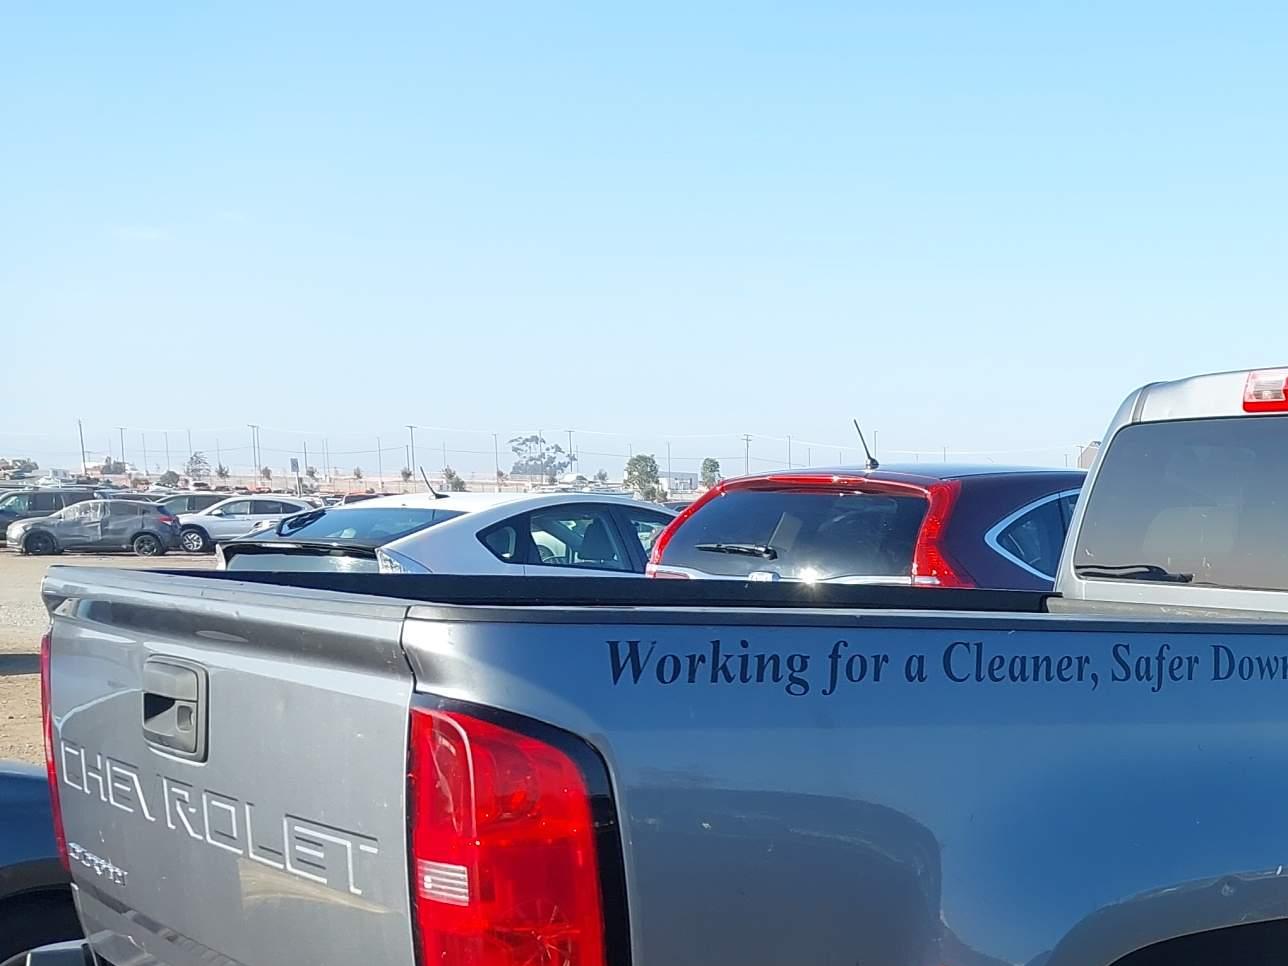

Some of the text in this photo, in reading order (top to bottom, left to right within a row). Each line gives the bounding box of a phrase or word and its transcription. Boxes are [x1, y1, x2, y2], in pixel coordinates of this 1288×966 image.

[605, 639, 811, 696] Working
[822, 640, 889, 696] for
[904, 653, 928, 682] a
[942, 641, 1099, 689] Cleaner,
[1111, 643, 1200, 693] Safer
[61, 739, 378, 895] CHEVROLET
